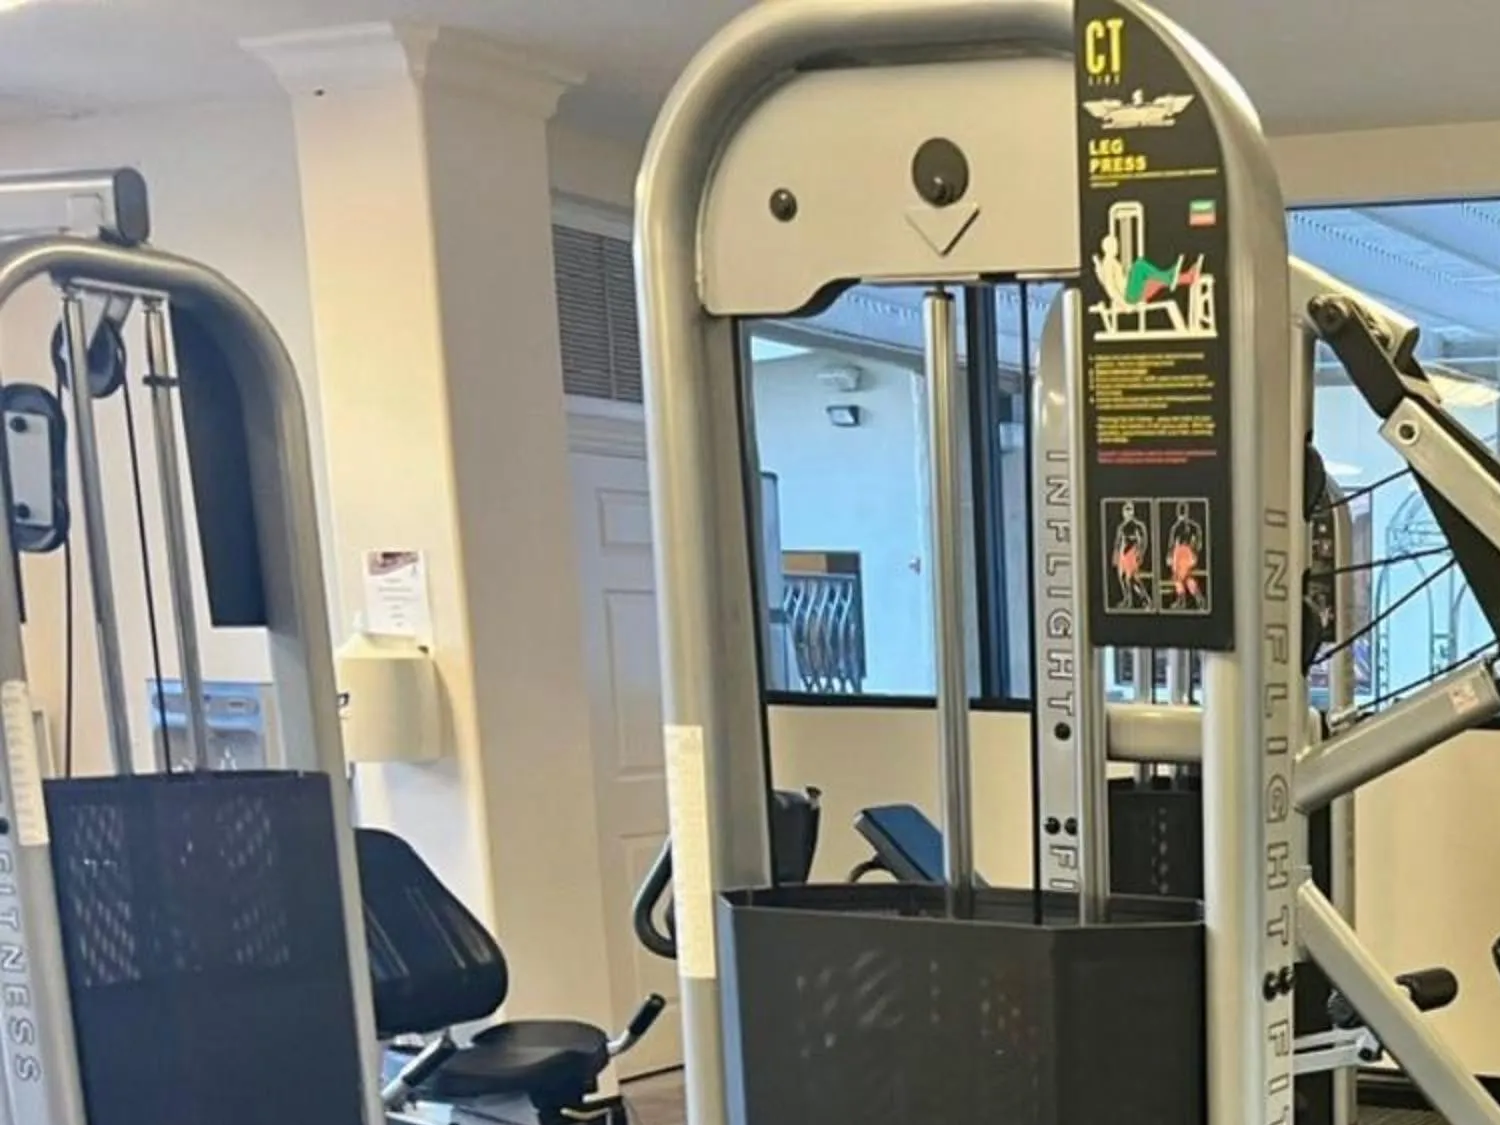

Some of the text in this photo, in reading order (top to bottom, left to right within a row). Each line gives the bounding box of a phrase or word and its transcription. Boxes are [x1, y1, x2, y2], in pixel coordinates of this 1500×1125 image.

[1085, 19, 1124, 75] CT
[1088, 138, 1124, 156] LEG
[1089, 155, 1148, 174] PRESS
[1046, 450, 1073, 719] INFLIGHT
[1264, 508, 1290, 948] INFLIGHT
